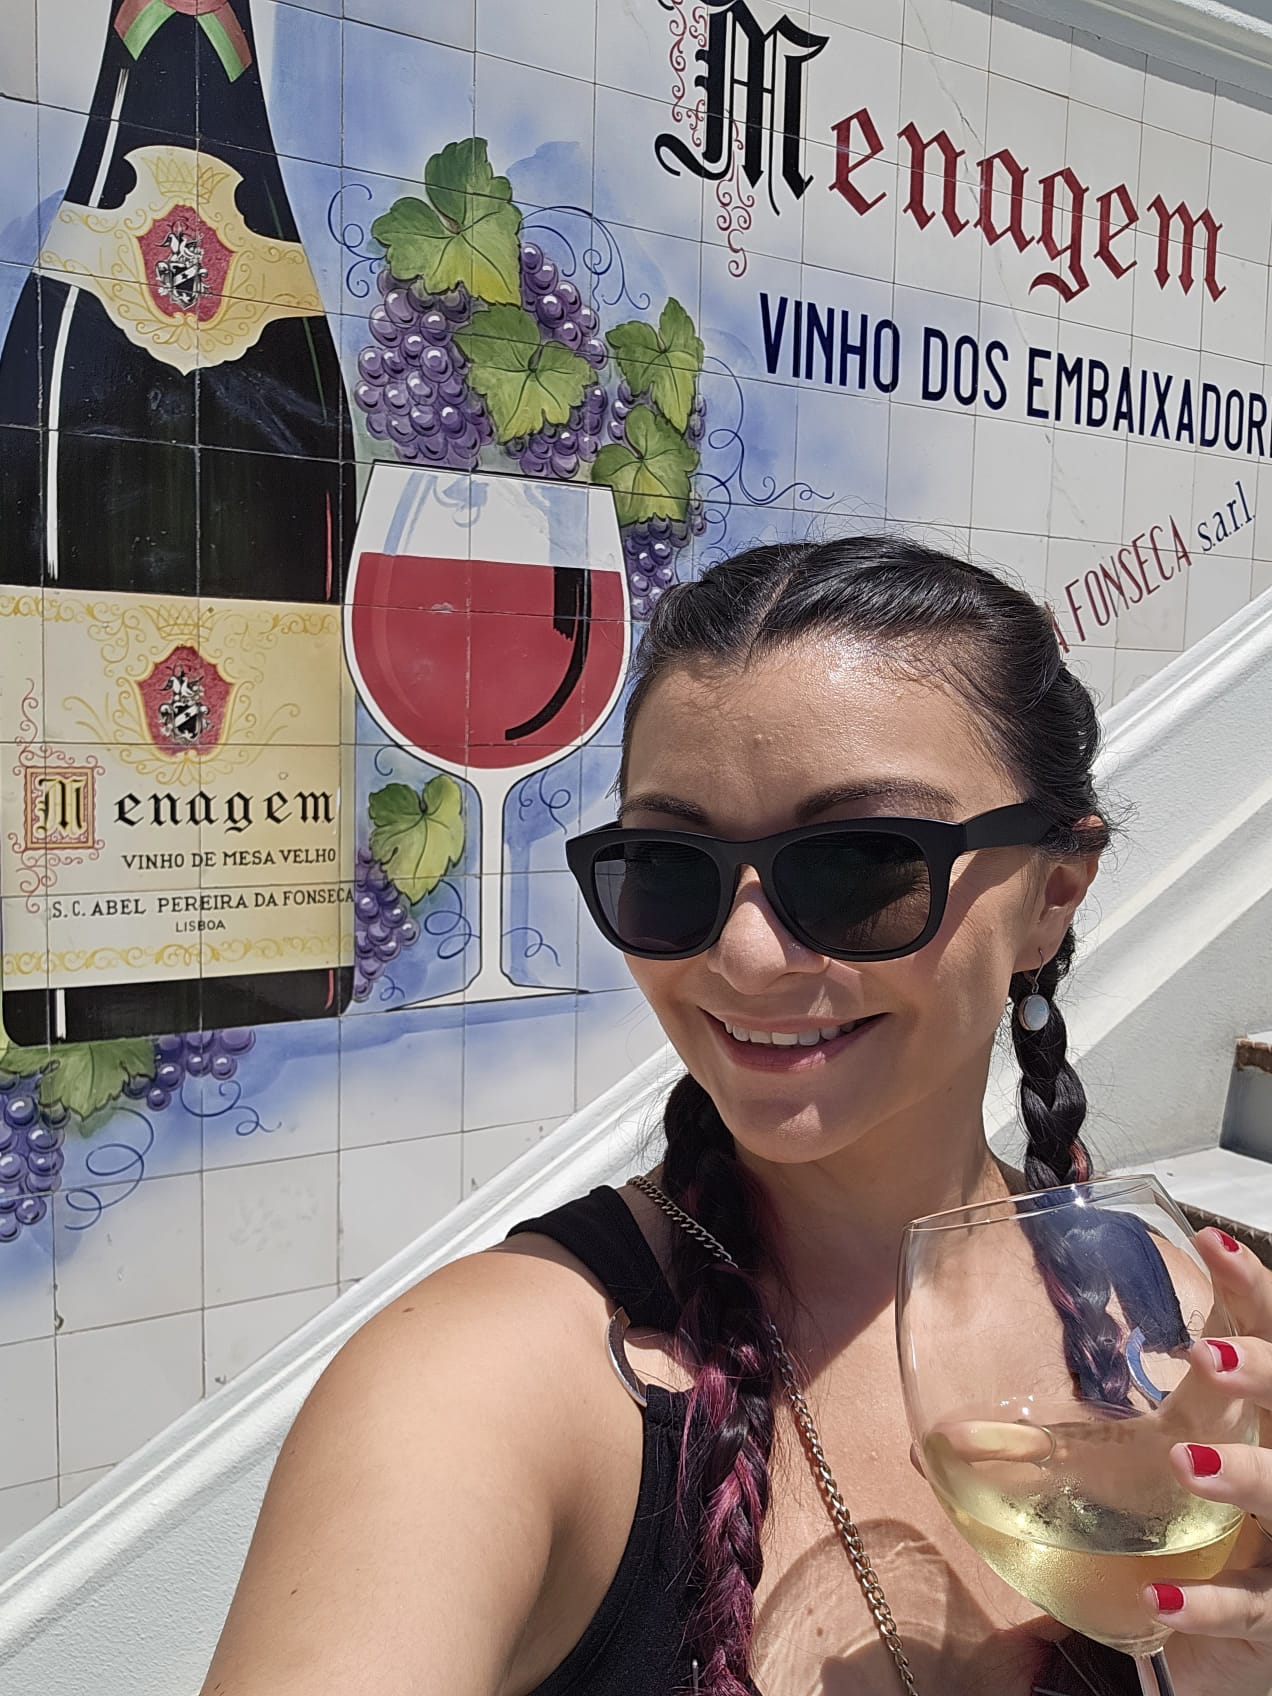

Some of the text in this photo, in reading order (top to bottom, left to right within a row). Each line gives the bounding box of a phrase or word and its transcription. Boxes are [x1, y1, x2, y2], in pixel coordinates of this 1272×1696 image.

[654, 0, 1227, 302] Menagem
[759, 292, 1272, 458] VINHO DOS EMBAIXADOR
[1064, 514, 1192, 642] FONSECA
[122, 848, 337, 870] VINHO DE MESA VELHO
[91, 898, 147, 917] ABEL
[157, 894, 249, 913] PEREIRA
[254, 892, 278, 908] DA
[283, 887, 355, 906] FONSECA
[175, 919, 226, 933] LISBOA
